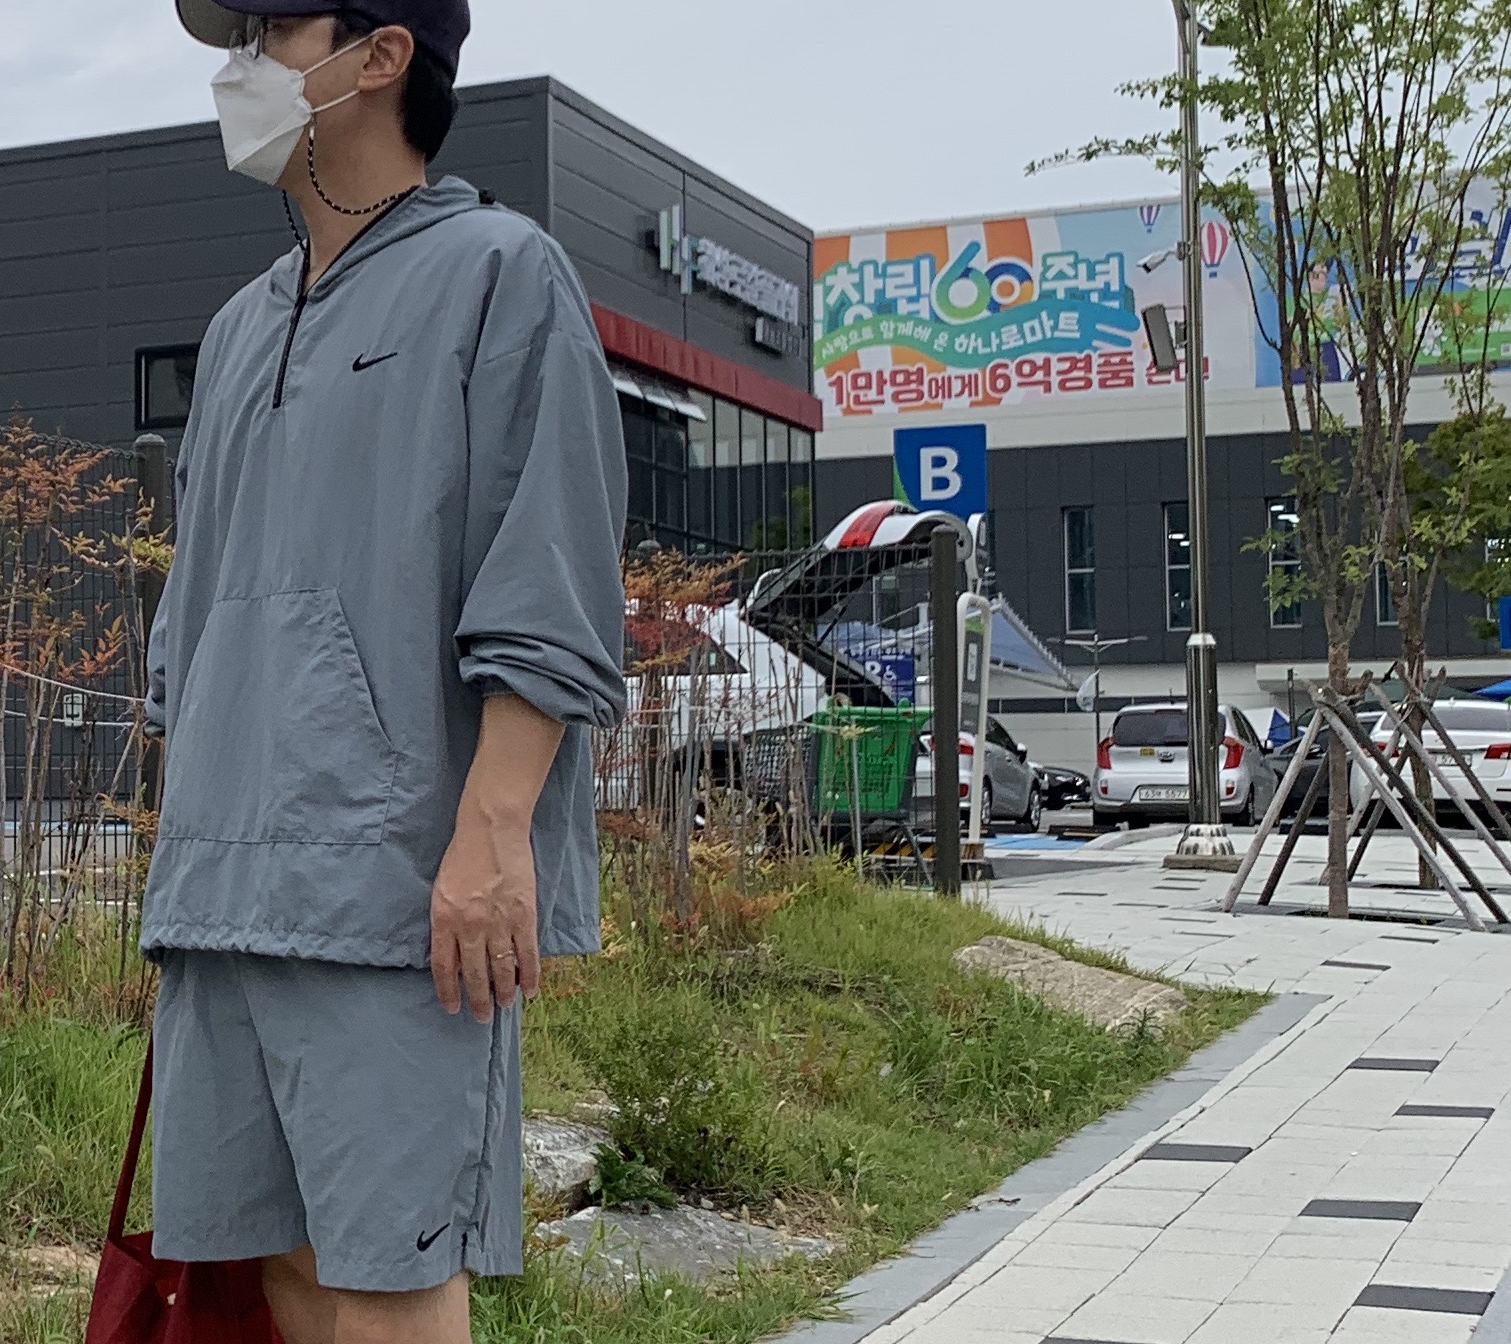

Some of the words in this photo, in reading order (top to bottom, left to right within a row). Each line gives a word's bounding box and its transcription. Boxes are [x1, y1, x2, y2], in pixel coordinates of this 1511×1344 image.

[954, 309, 1081, 355] 하나로마트
[828, 366, 980, 406] 1만명에게
[988, 351, 1135, 394] 6억경품
[919, 446, 963, 503] B
